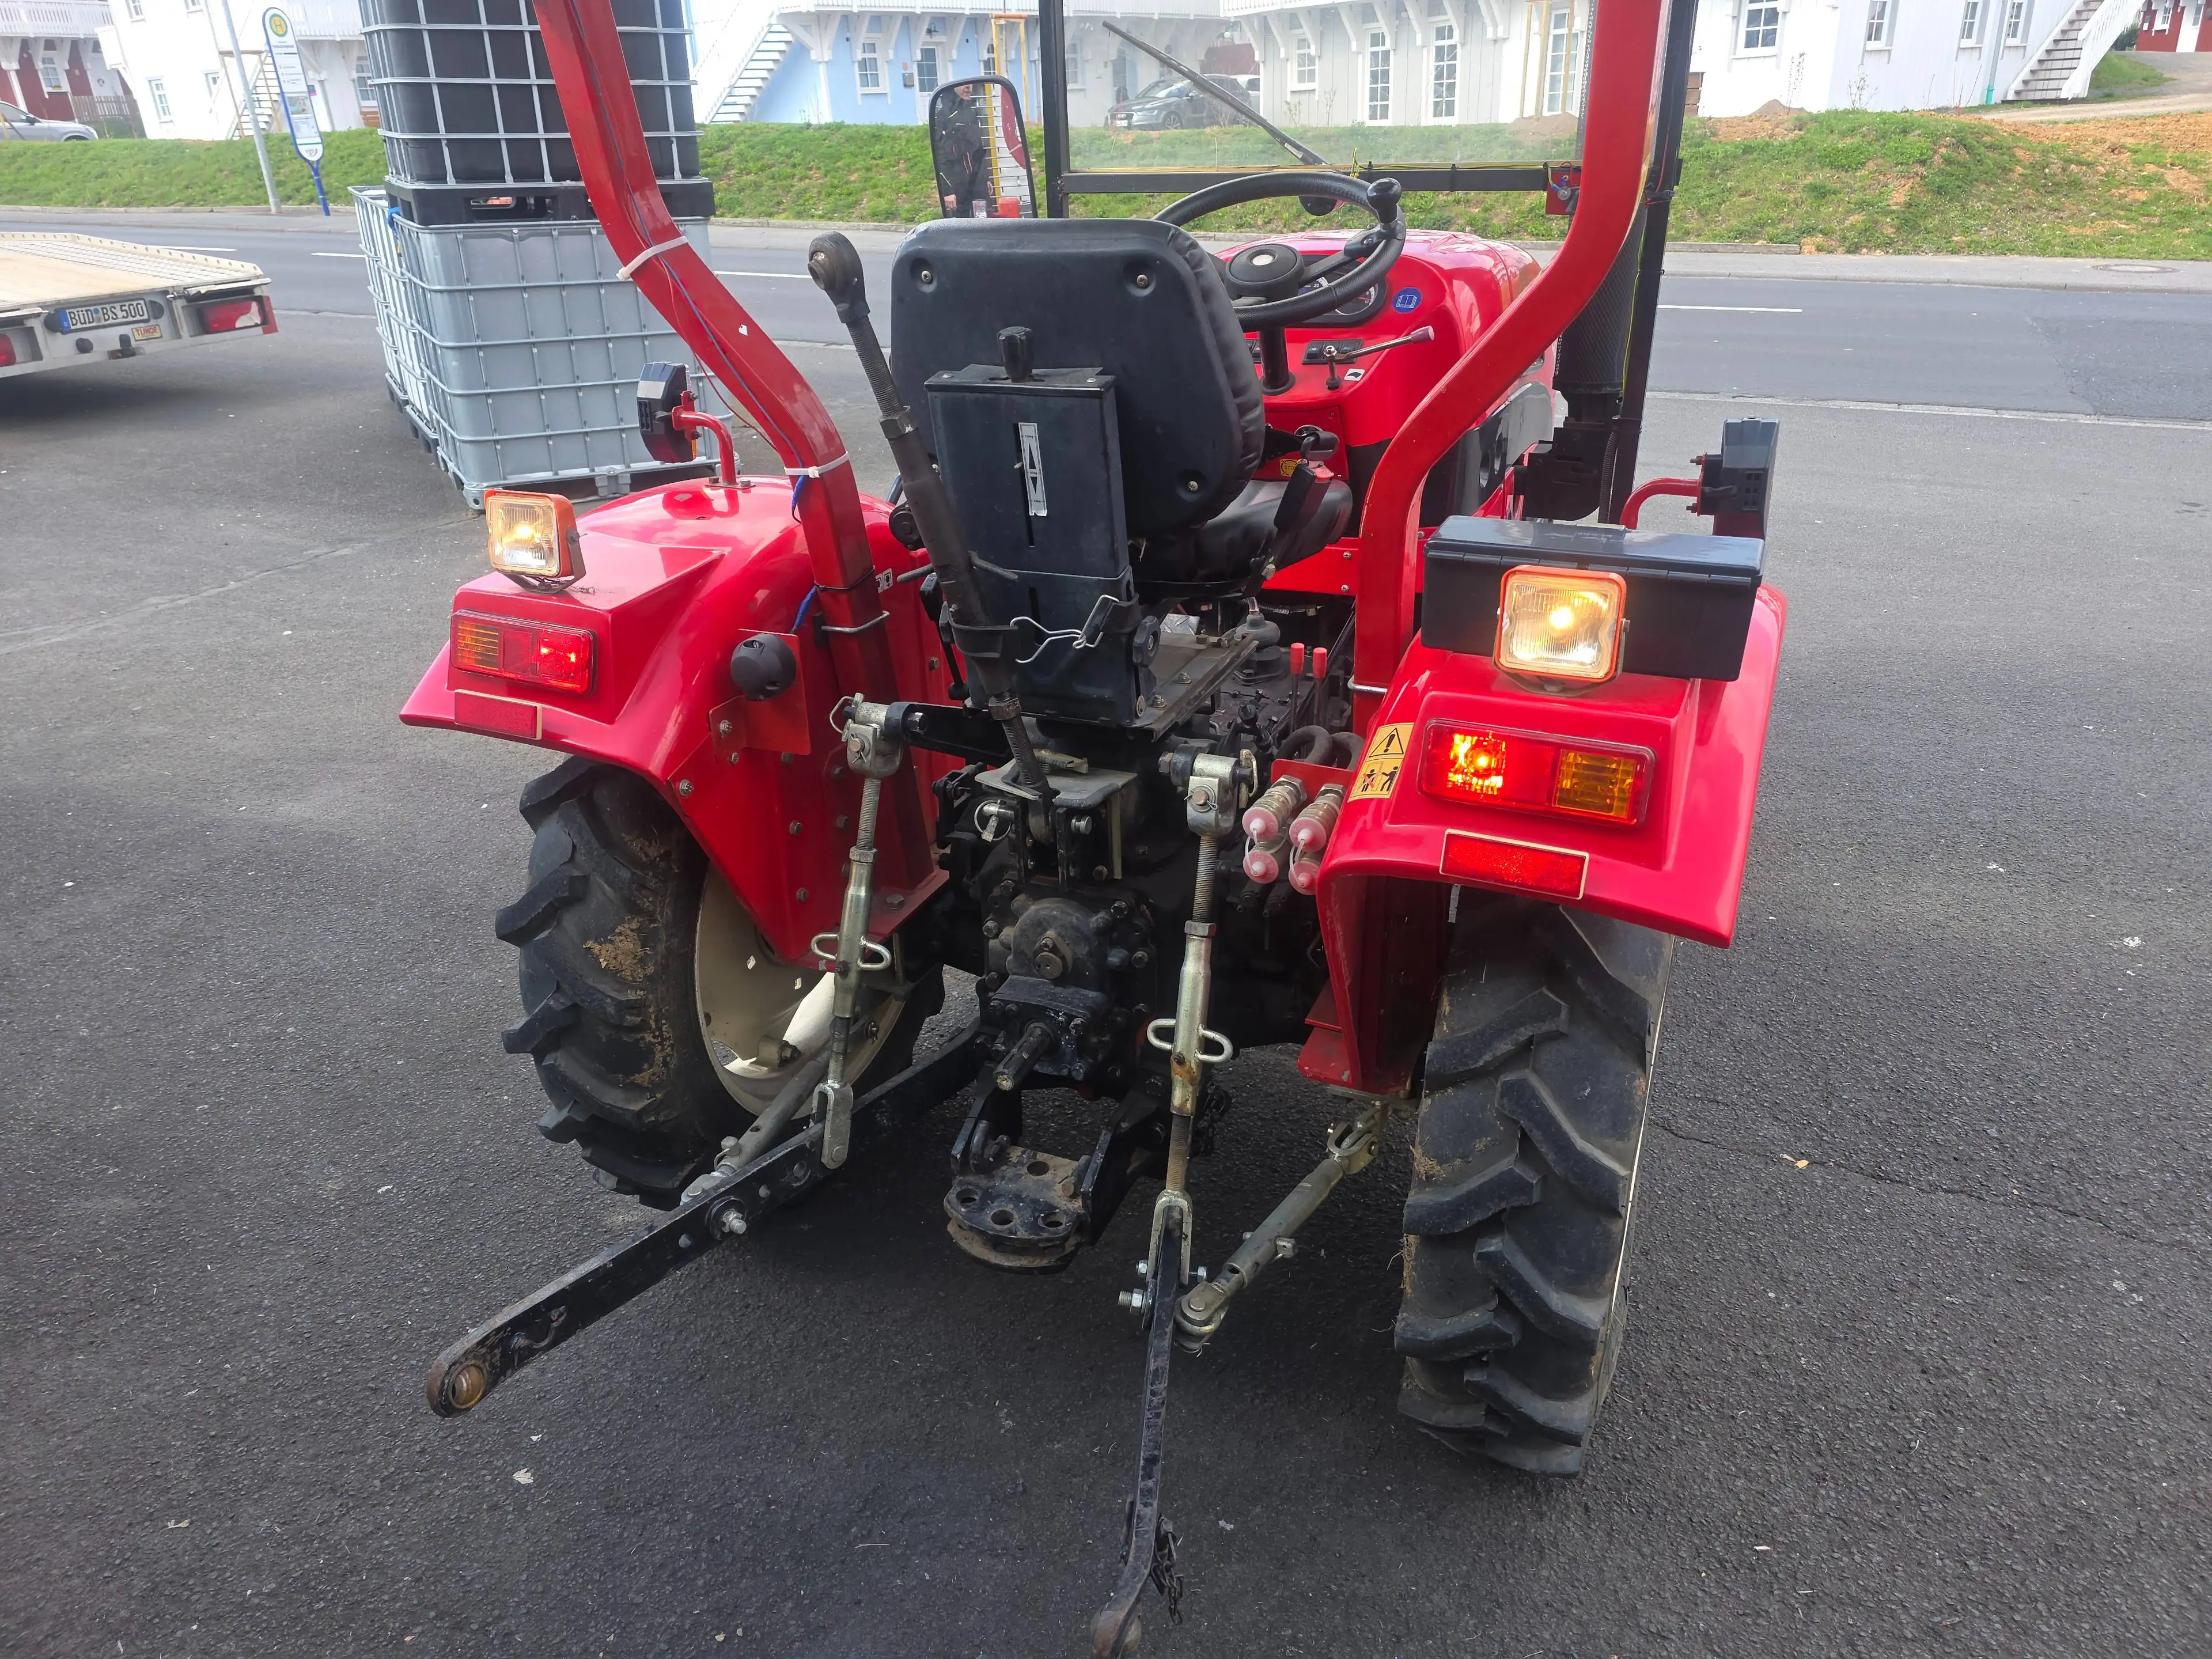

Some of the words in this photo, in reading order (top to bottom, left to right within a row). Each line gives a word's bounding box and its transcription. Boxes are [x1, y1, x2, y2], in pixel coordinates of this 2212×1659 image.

[273, 18, 284, 33] H
[69, 308, 95, 327] BÜD
[101, 306, 118, 322] BS
[119, 302, 145, 319] 500
